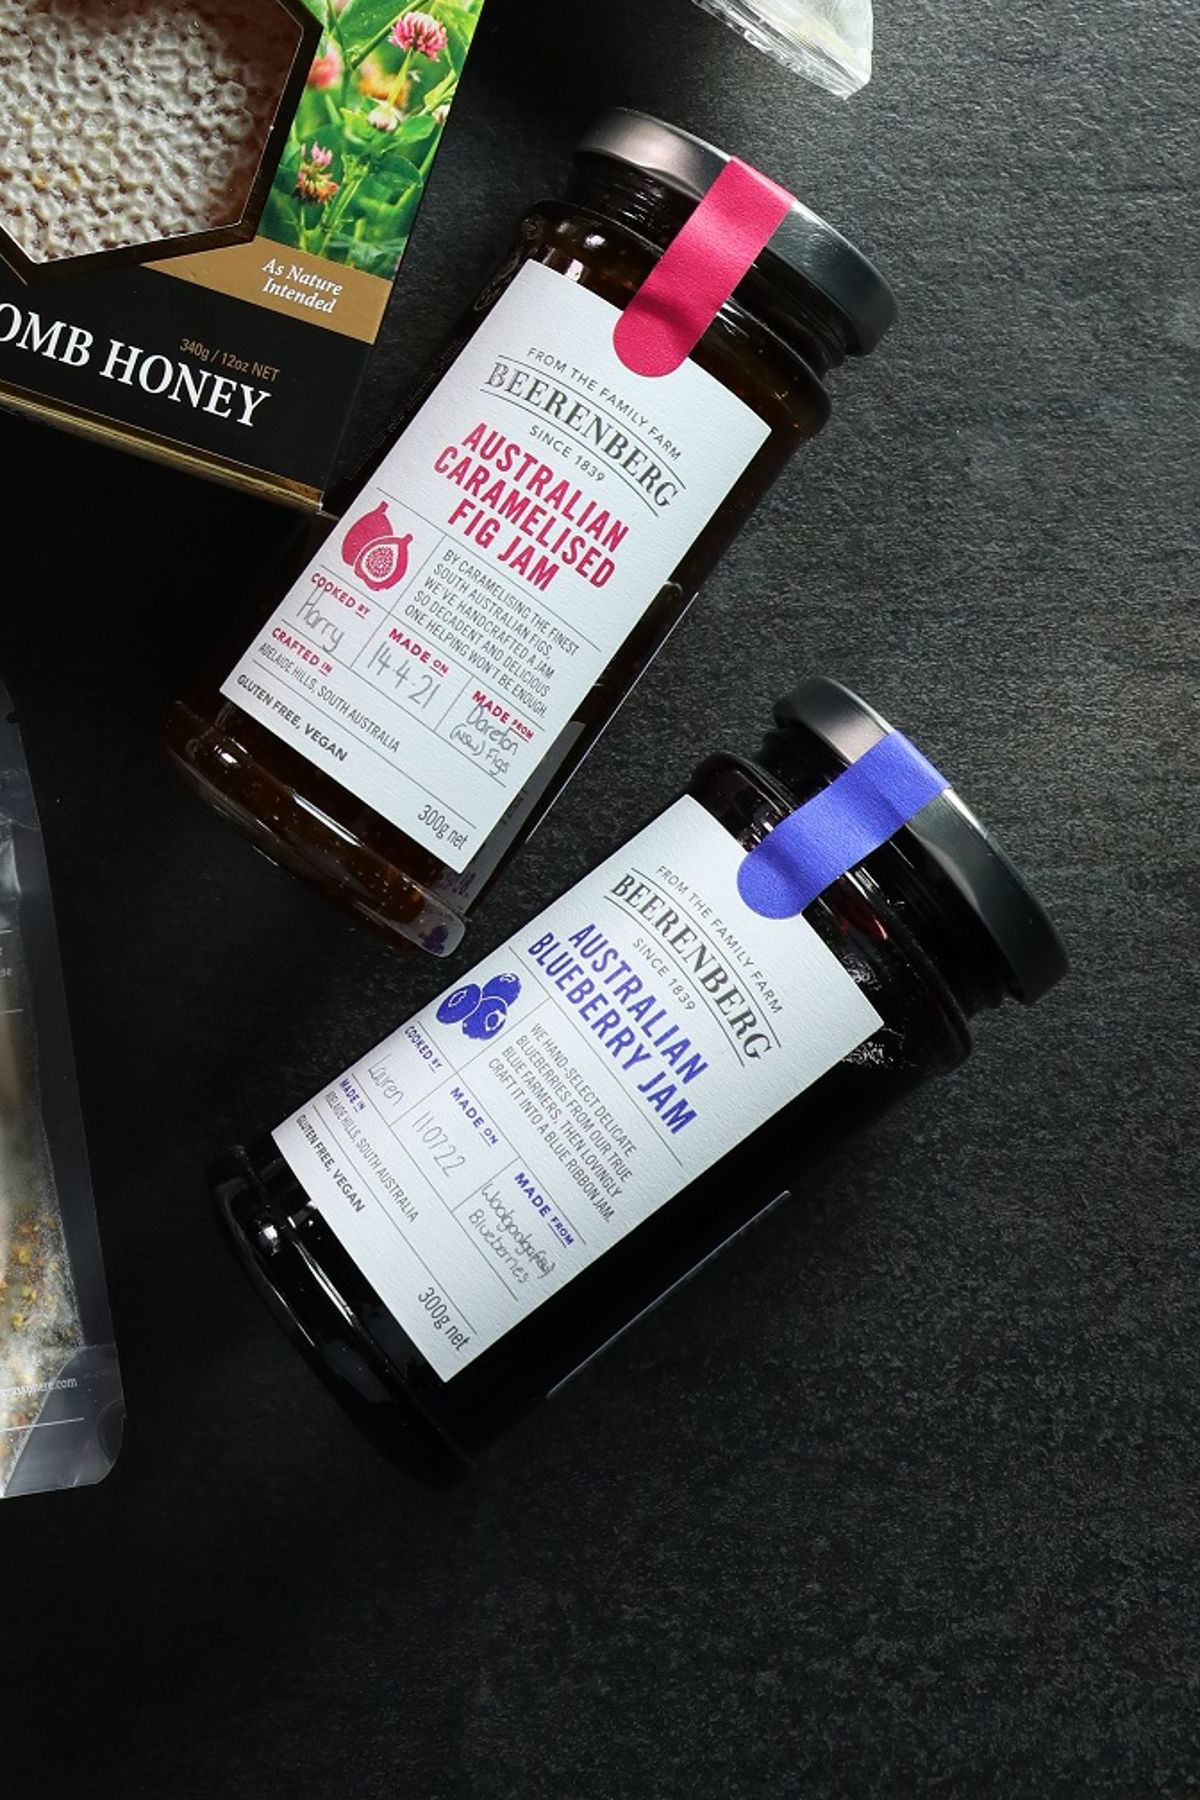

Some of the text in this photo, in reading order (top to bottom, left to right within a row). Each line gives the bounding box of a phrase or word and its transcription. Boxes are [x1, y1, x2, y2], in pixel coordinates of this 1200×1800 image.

[261, 255, 344, 296] As Nature
[261, 276, 337, 314] Intended
[99, 337, 272, 430] HONEY
[178, 337, 280, 382] 340g 12oz NET
[526, 346, 681, 461] FROM THE FAMILY FARM
[481, 359, 680, 511] BEERENBERG
[528, 423, 606, 483] SINCE 1839
[431, 442, 617, 591] CARAMELISED
[461, 418, 629, 553] AUSTRALIAN
[446, 497, 561, 592] FIG JAM
[294, 584, 346, 655] Harry
[310, 571, 356, 609] COOKED
[421, 575, 556, 680] WE'VE HANDCRAFTED A JAM
[431, 562, 555, 659] SOUTH AUSTRALIAN FIGS,
[441, 548, 579, 657] BY CARAMELISING THE FINEST
[270, 627, 320, 667] CRAFTED
[387, 627, 449, 675] MADE ON
[402, 603, 428, 627] ONE
[423, 619, 471, 659] HELPING
[496, 674, 515, 692] BE
[412, 589, 551, 698] SO DECADENT AND DELICIOUS
[235, 673, 348, 762] GLUTEN FREE, VEGAN
[315, 685, 401, 754] SOUTH AUSTRALIA
[470, 689, 535, 741] MADE FROM
[416, 803, 470, 851] 300g net
[608, 872, 774, 1064] BEERENBERG
[631, 936, 697, 1012] SINCE 1839
[655, 864, 782, 1015] FROM THE FAMILY FARM
[403, 1024, 434, 1061] COOKED
[527, 927, 698, 1139] BLUEBERRY JAM
[567, 918, 709, 1086] AUSTRALIAN
[448, 1086, 499, 1145] MADE ON
[487, 1057, 517, 1092] CRAFT
[509, 1086, 525, 1102] IT
[518, 1097, 543, 1126] INTO
[536, 1121, 550, 1135] A
[543, 1130, 571, 1162] BLUE
[563, 1158, 600, 1201] RIBBON
[501, 1046, 623, 1199] BLUE FARMERS, THEN LOVINGLY
[515, 1034, 633, 1183] BLUEBERRIES FROM OUR TRUE
[529, 1022, 637, 1157] WE HAND-SELECT DELICATE
[329, 1168, 365, 1213] VEGAN
[355, 1136, 420, 1223] SOUTH AUSTRALIA
[512, 1171, 575, 1246] MADE FROM
[416, 1286, 471, 1351] 300g net
